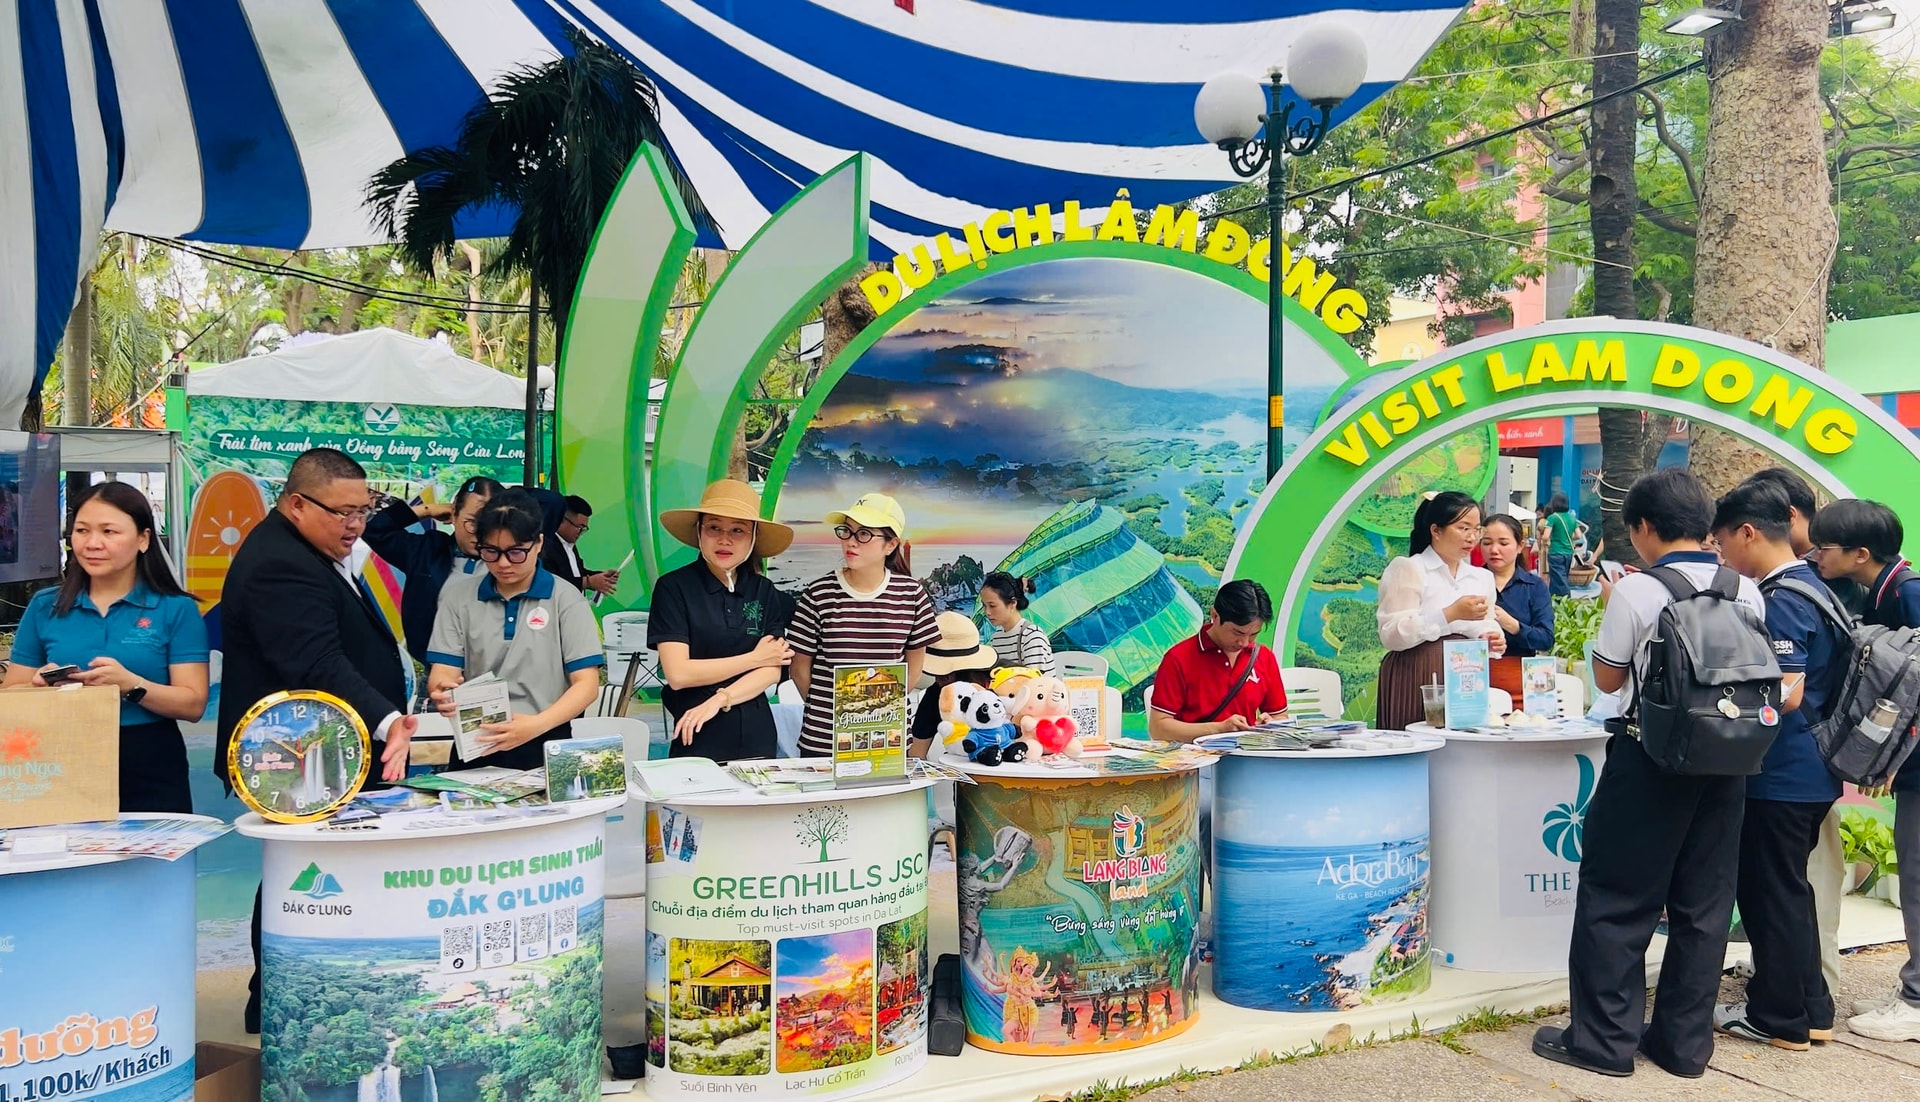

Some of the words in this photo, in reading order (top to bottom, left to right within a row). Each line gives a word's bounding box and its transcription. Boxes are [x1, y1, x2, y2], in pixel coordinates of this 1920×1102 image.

[859, 242, 936, 317] DU
[935, 202, 1053, 274] LỊCH
[1063, 187, 1200, 253] LÂM
[1324, 364, 1467, 467] VISIT
[1486, 340, 1627, 393] LAM
[1652, 343, 1858, 455] DONG
[217, 433, 245, 450] Trái
[276, 437, 312, 452] xanh
[346, 438, 384, 460] Đồng
[388, 440, 422, 461] bằng
[426, 441, 460, 463] Sông
[464, 442, 491, 458] Cửu
[266, 712, 280, 725] 11
[291, 705, 307, 718] 12
[338, 725, 347, 738] 2
[242, 753, 253, 767] 9
[346, 746, 355, 760] 3
[250, 775, 260, 789] 8
[271, 792, 279, 805] 7
[296, 796, 306, 809] 6
[322, 787, 331, 800] 5
[384, 869, 434, 889] KHU
[440, 866, 473, 886] DU
[478, 859, 524, 885] LỊCH
[528, 850, 573, 874] SINH
[576, 835, 603, 864] THÁI
[1082, 860, 1126, 882] LANG
[1316, 849, 1419, 888] AdoraBay
[692, 864, 882, 900] GREENHILLS
[888, 852, 923, 883] JSC
[1524, 871, 1571, 892] THE
[1110, 876, 1148, 900] land
[427, 887, 489, 919] ĐẮK
[652, 900, 683, 916] Chuỗi
[686, 906, 708, 920] địa
[711, 904, 747, 918] điểm
[750, 906, 769, 918] du
[773, 904, 797, 919] lịch
[801, 903, 835, 915] tham
[838, 899, 868, 913] quan
[871, 891, 897, 904] hàng
[737, 923, 760, 936] Top
[763, 920, 824, 933] must-visit
[828, 914, 860, 930] spots
[862, 911, 872, 922] in
[1091, 917, 1115, 934] sáng
[680, 1080, 705, 1092] Suối
[735, 1083, 757, 1093] Yên
